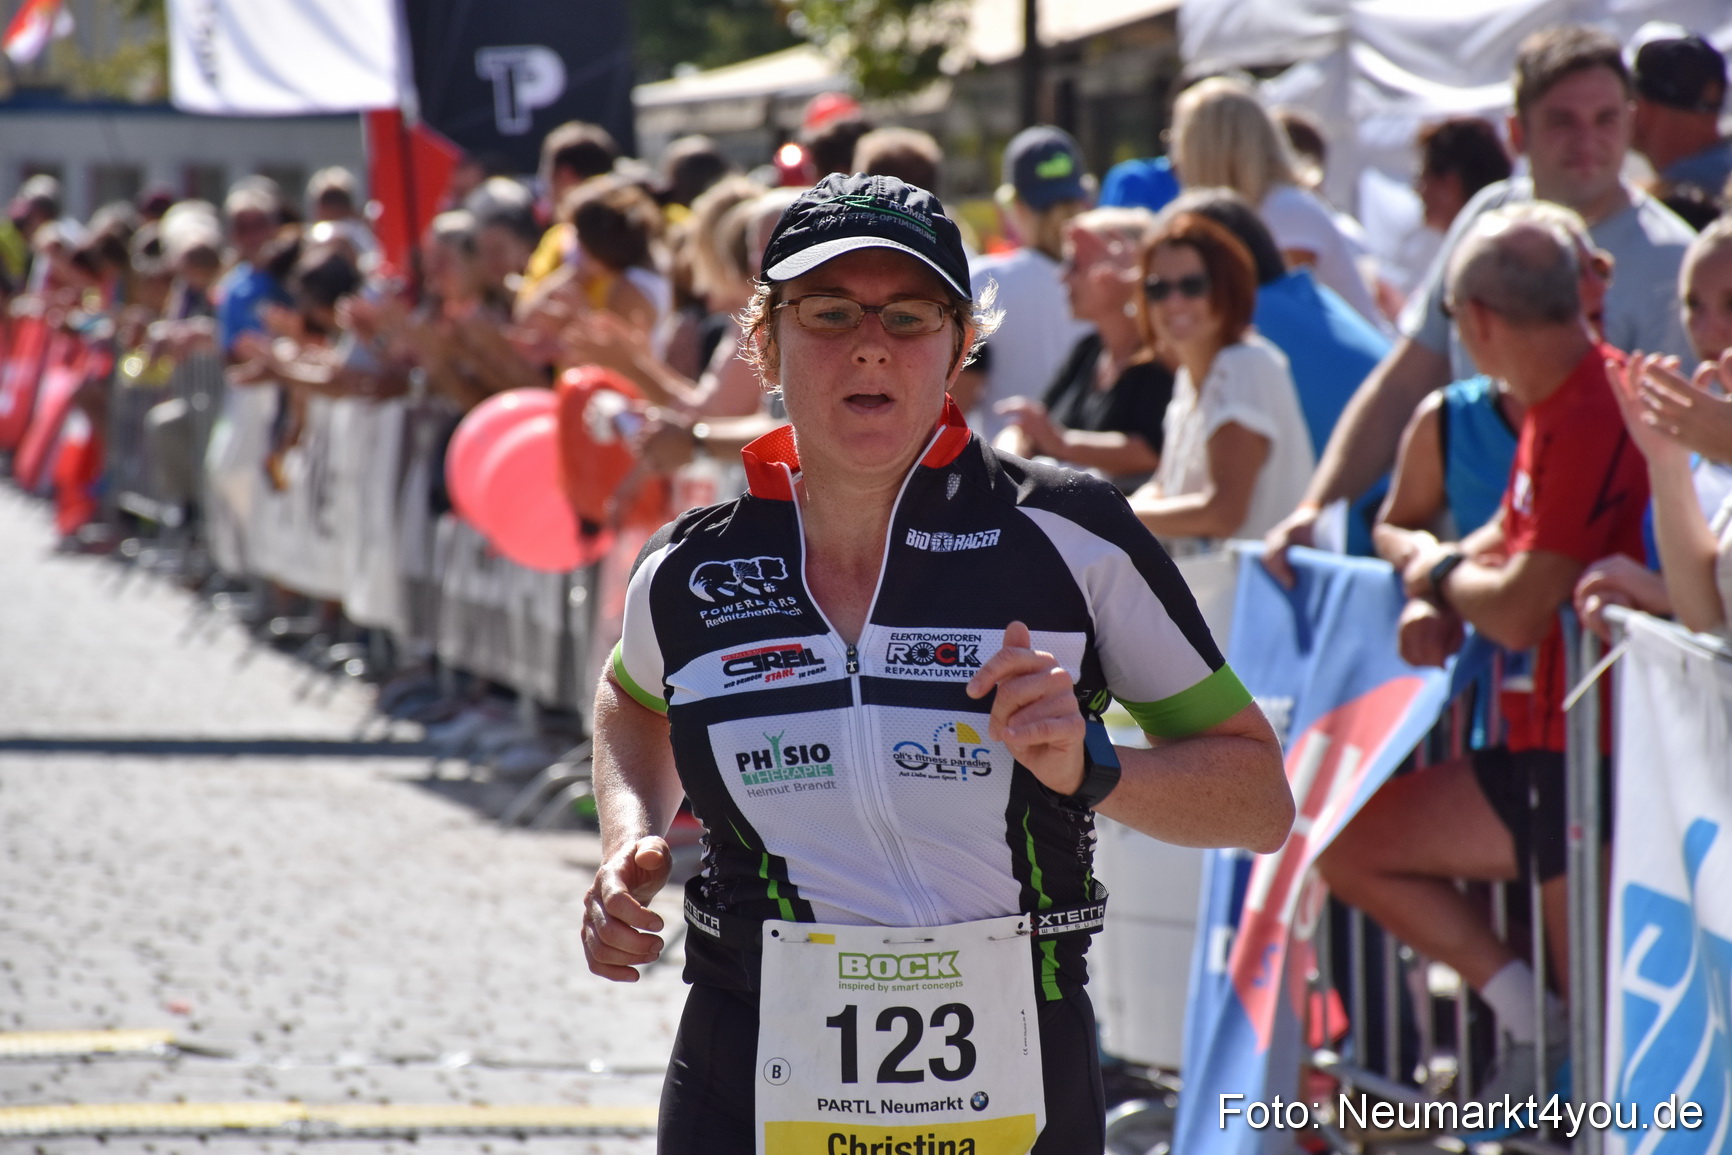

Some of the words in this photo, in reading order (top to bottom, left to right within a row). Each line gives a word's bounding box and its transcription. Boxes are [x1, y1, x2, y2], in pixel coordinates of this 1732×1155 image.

[890, 632, 982, 643] ELEKTROMOTOREN
[722, 648, 824, 676] GREIL
[885, 641, 982, 667] ROCK
[764, 668, 794, 683] STAHL
[884, 665, 978, 678] REPARATURWER
[915, 754, 948, 765] fitness
[950, 759, 992, 768] paradies
[743, 764, 830, 785] THERAPIE
[747, 784, 791, 799] Helmut
[793, 780, 837, 792] Brandt
[1038, 904, 1104, 927] XTERRA
[838, 950, 962, 981] BOCK
[838, 981, 876, 992] inspired
[877, 983, 889, 993] by
[891, 983, 919, 992] smart
[921, 980, 964, 990] concepts
[826, 1002, 977, 1084] 123
[771, 1064, 782, 1080] B
[817, 1098, 877, 1114] PARTL
[880, 1096, 964, 1114] Neumarkt
[827, 1132, 975, 1155] Christina
